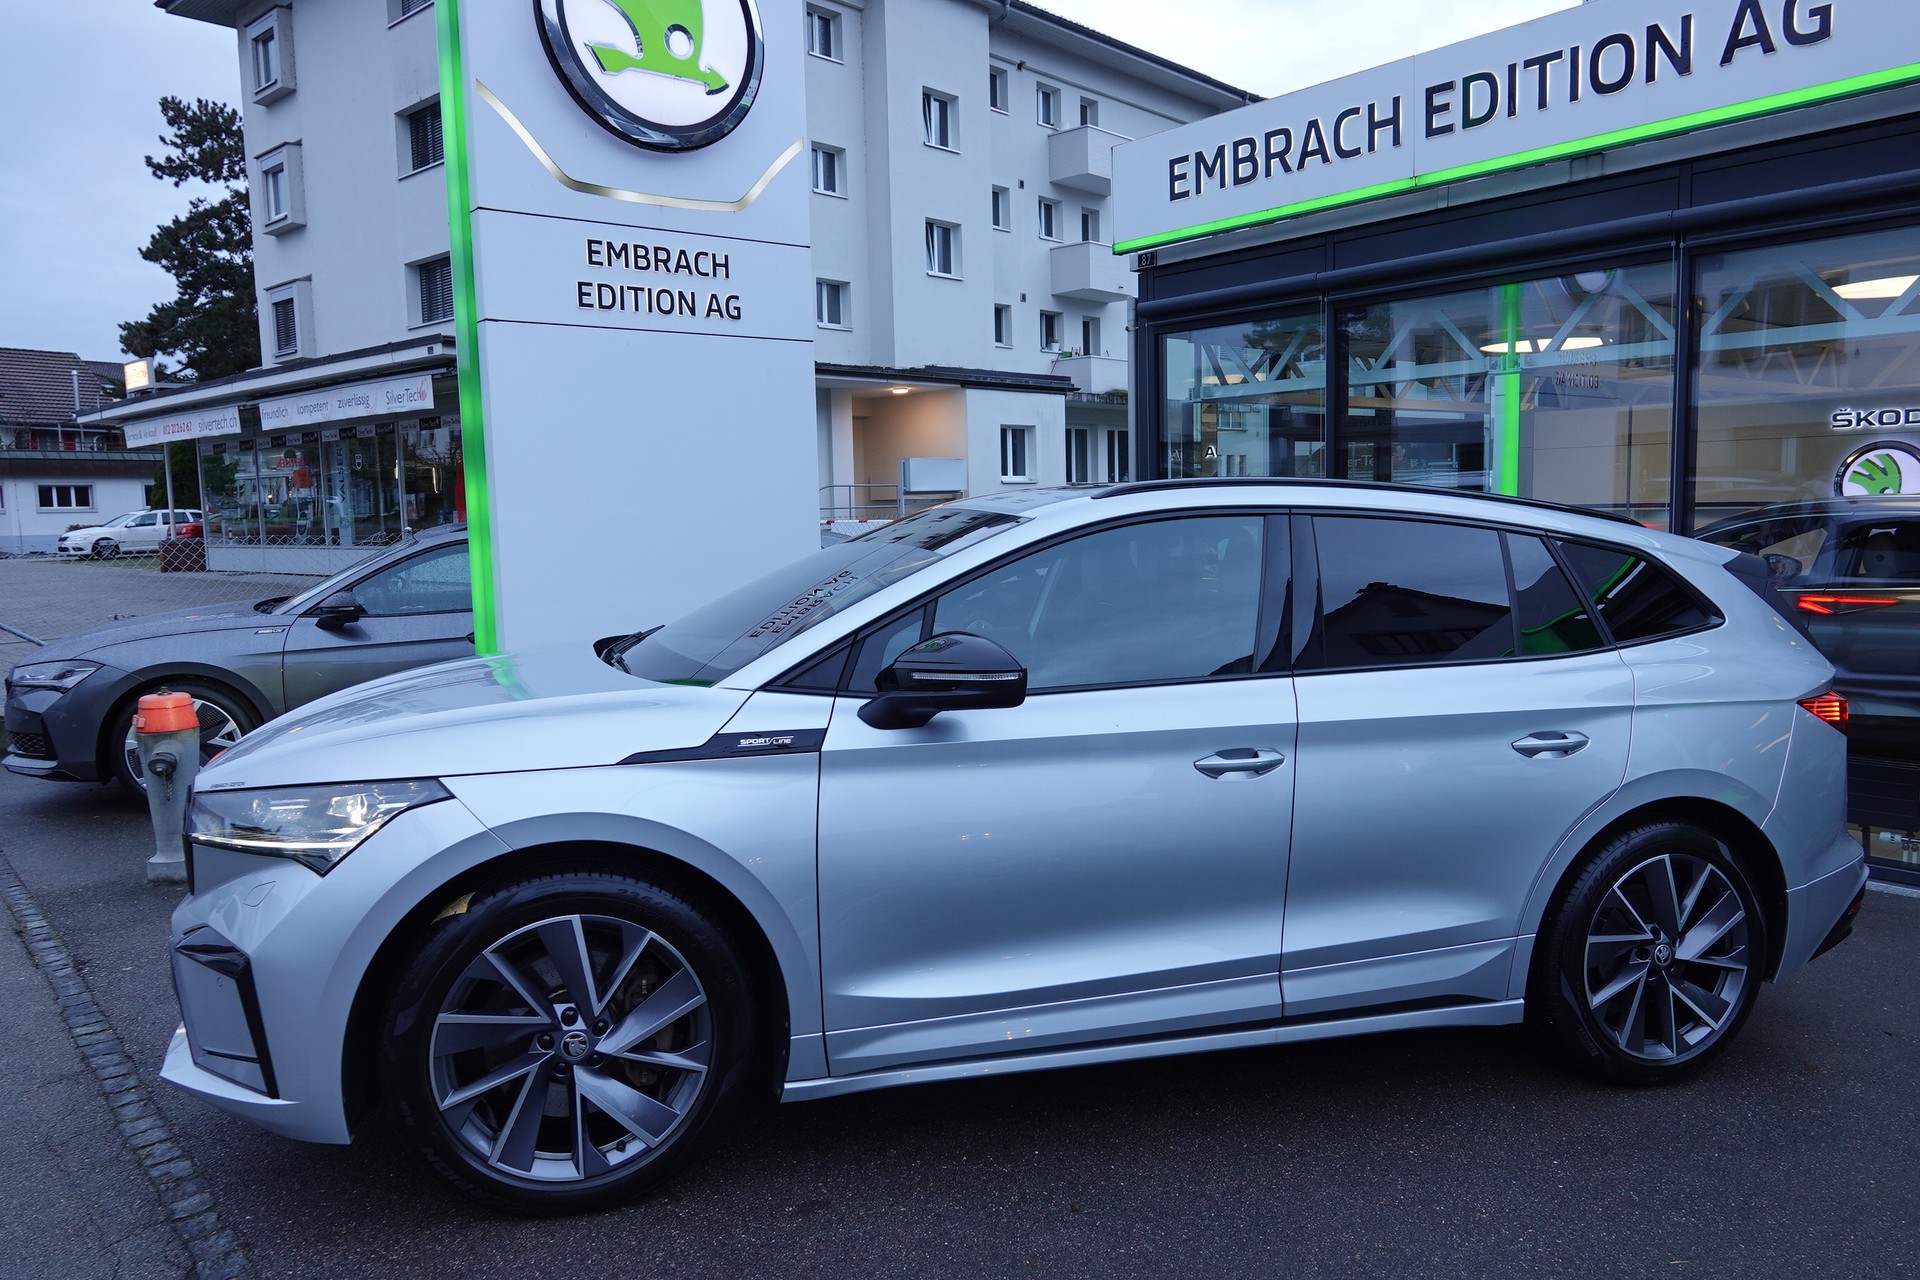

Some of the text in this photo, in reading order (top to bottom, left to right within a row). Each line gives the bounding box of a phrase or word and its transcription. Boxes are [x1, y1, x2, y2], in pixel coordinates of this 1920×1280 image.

[1167, 0, 1834, 202] EMBRACH EDITION AG
[585, 238, 731, 280] EMBRACH
[1141, 253, 1152, 266] 87
[576, 281, 742, 321] EDITION AG
[296, 401, 329, 417] kompetent
[385, 386, 421, 406] SilverTech
[197, 412, 238, 433] silvertech.ch
[336, 447, 346, 504] VALSER
